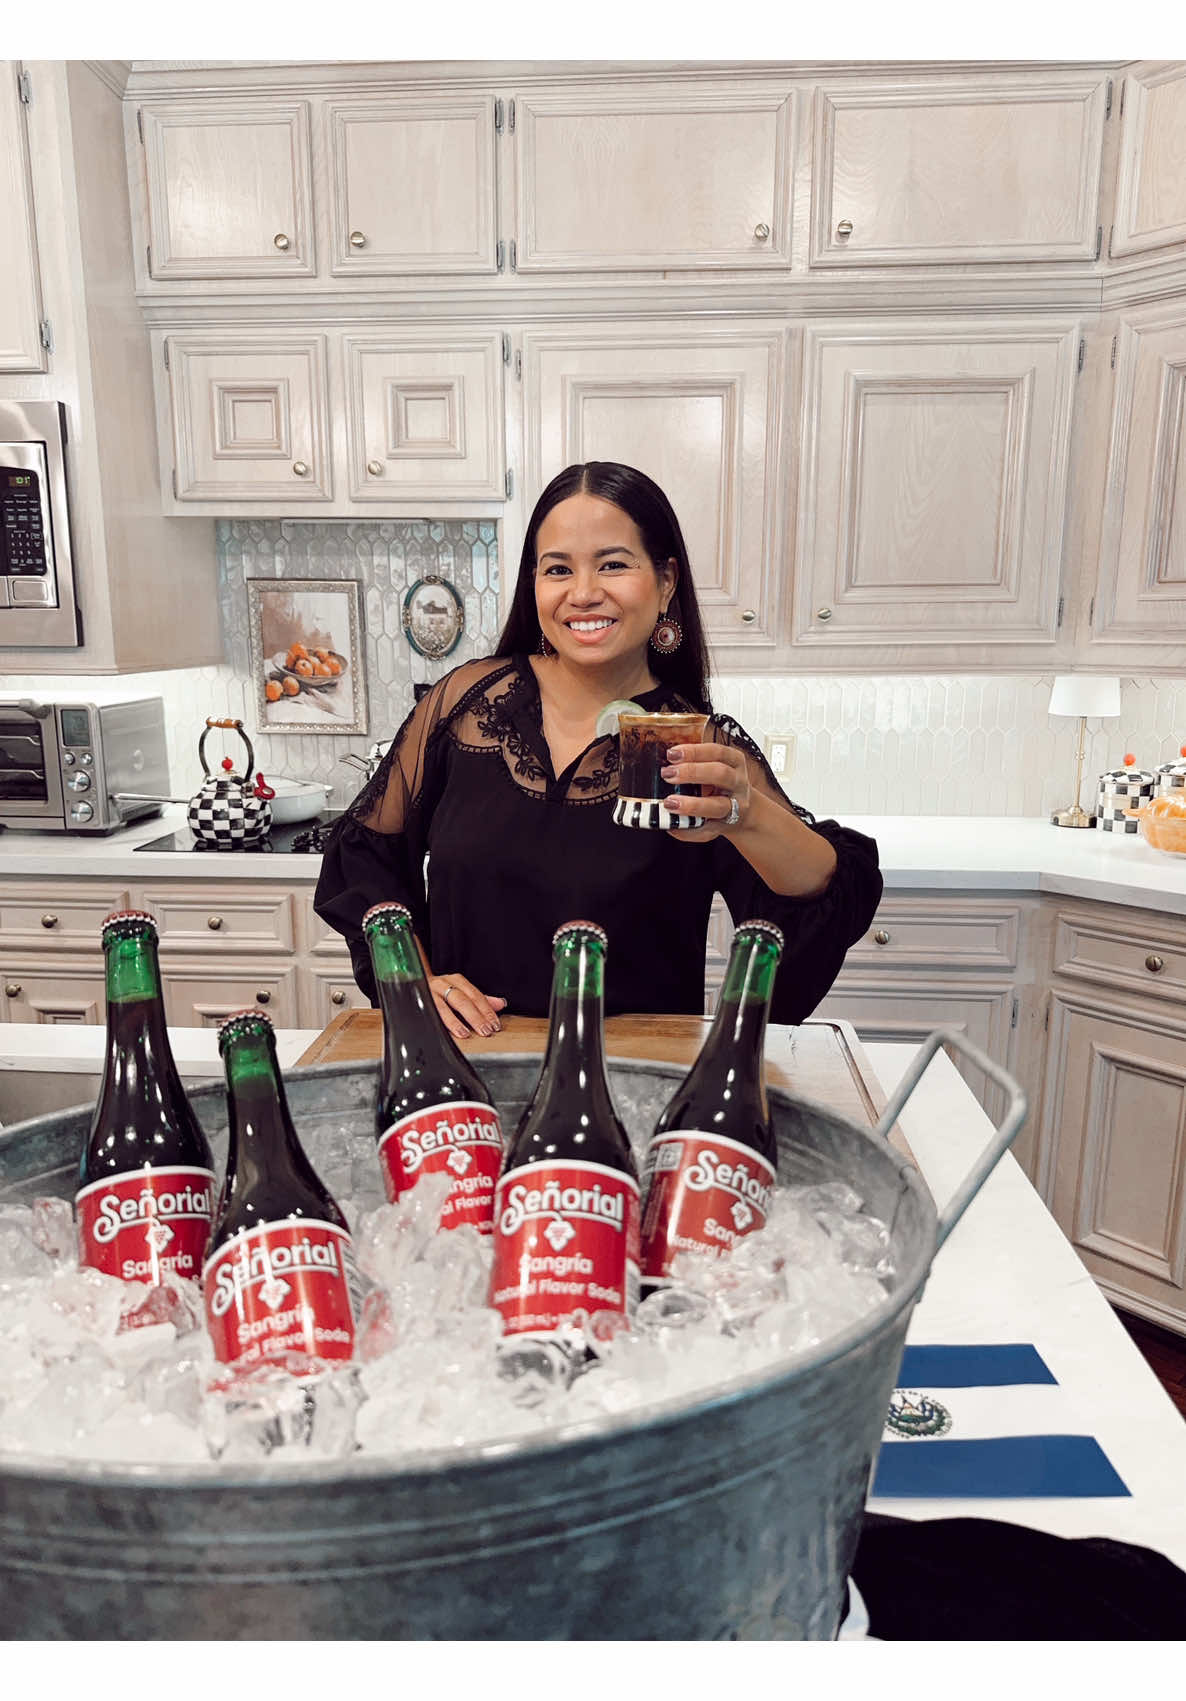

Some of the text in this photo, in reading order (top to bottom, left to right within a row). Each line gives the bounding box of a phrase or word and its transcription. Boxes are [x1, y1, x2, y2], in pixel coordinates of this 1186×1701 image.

[401, 1116, 500, 1174] Señorial
[449, 1172, 493, 1195] ngría
[500, 1179, 624, 1236] Señorial
[682, 1149, 769, 1210] Señori
[93, 1185, 211, 1244] Señorial
[211, 1237, 338, 1317] Señorial
[539, 1277, 586, 1296] Flavor
[587, 1282, 621, 1305] Soda
[236, 1303, 315, 1344] Sangrí
[262, 1331, 310, 1354] Flavo
[315, 1326, 351, 1344] Soda
